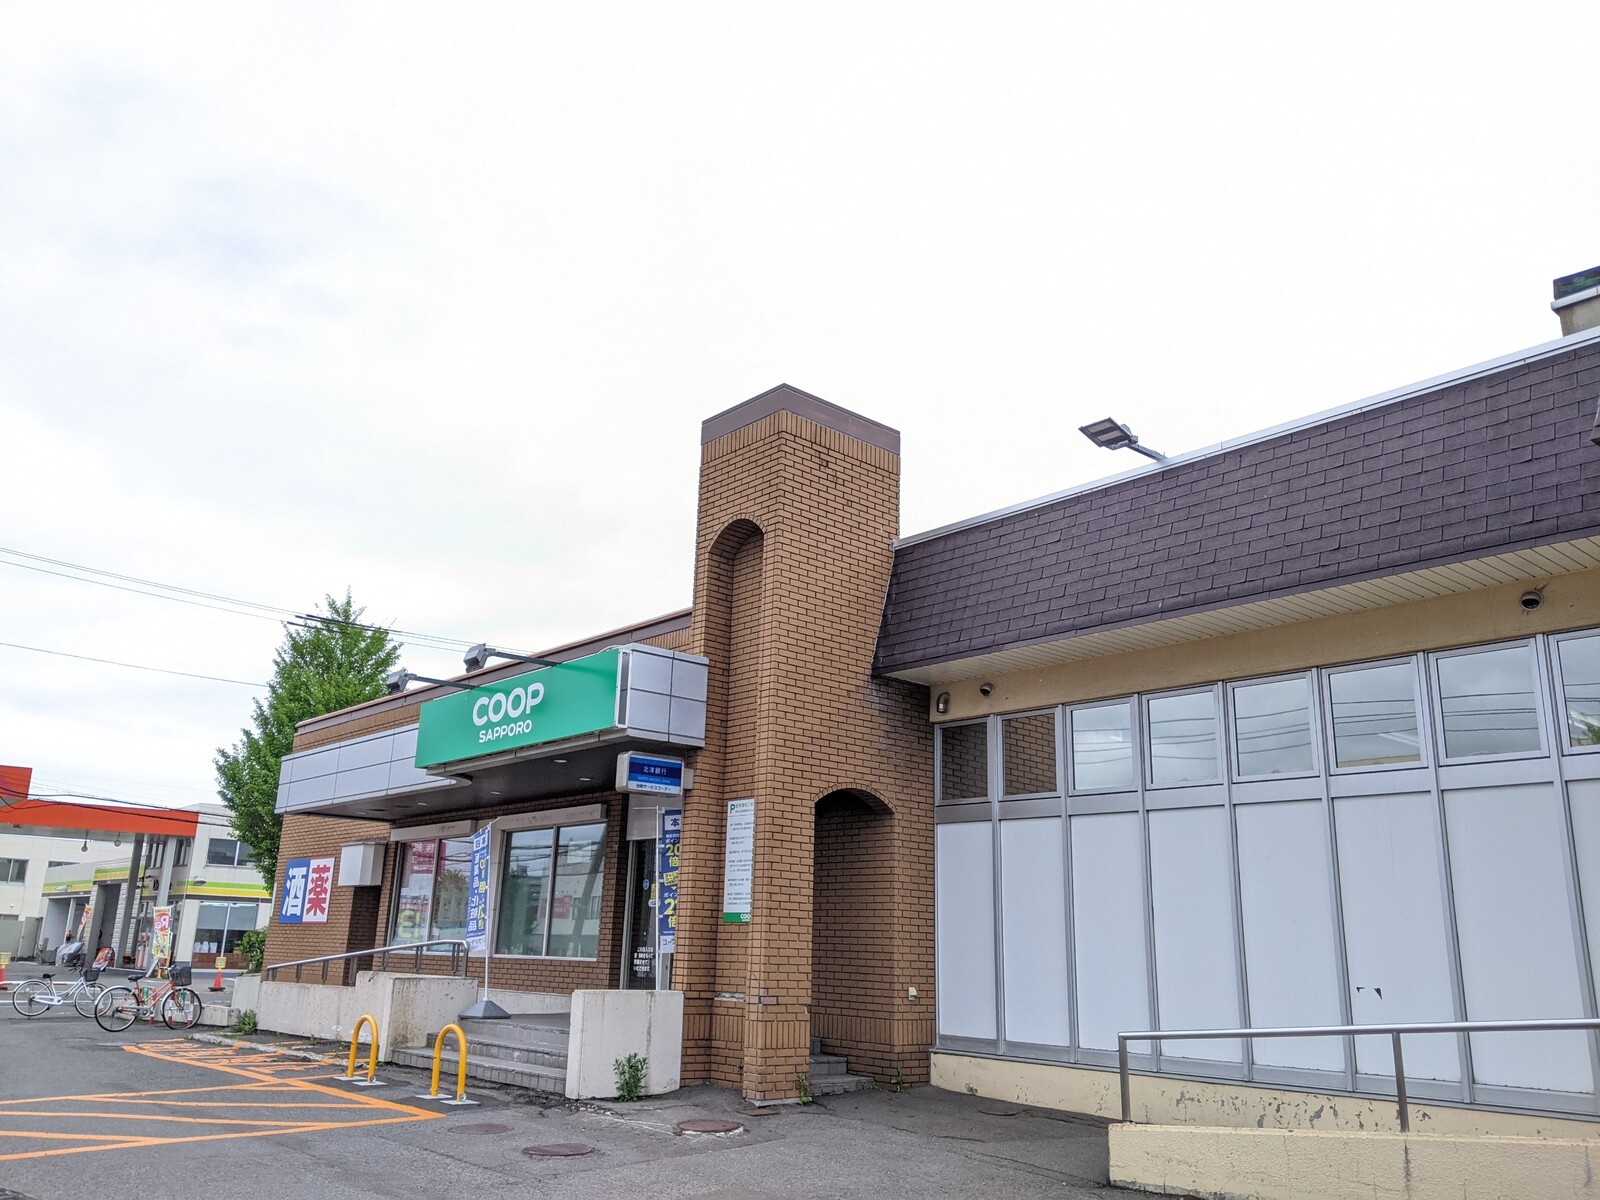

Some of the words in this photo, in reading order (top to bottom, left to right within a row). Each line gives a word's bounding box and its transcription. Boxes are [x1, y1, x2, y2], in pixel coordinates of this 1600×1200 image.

[472, 682, 545, 727] COOP
[478, 719, 533, 744] SAPPORO
[643, 766, 667, 775] 北洋銀行
[670, 817, 681, 829] 本
[665, 844, 681, 857] 20
[281, 866, 308, 917] 酒
[305, 864, 331, 917] 薬
